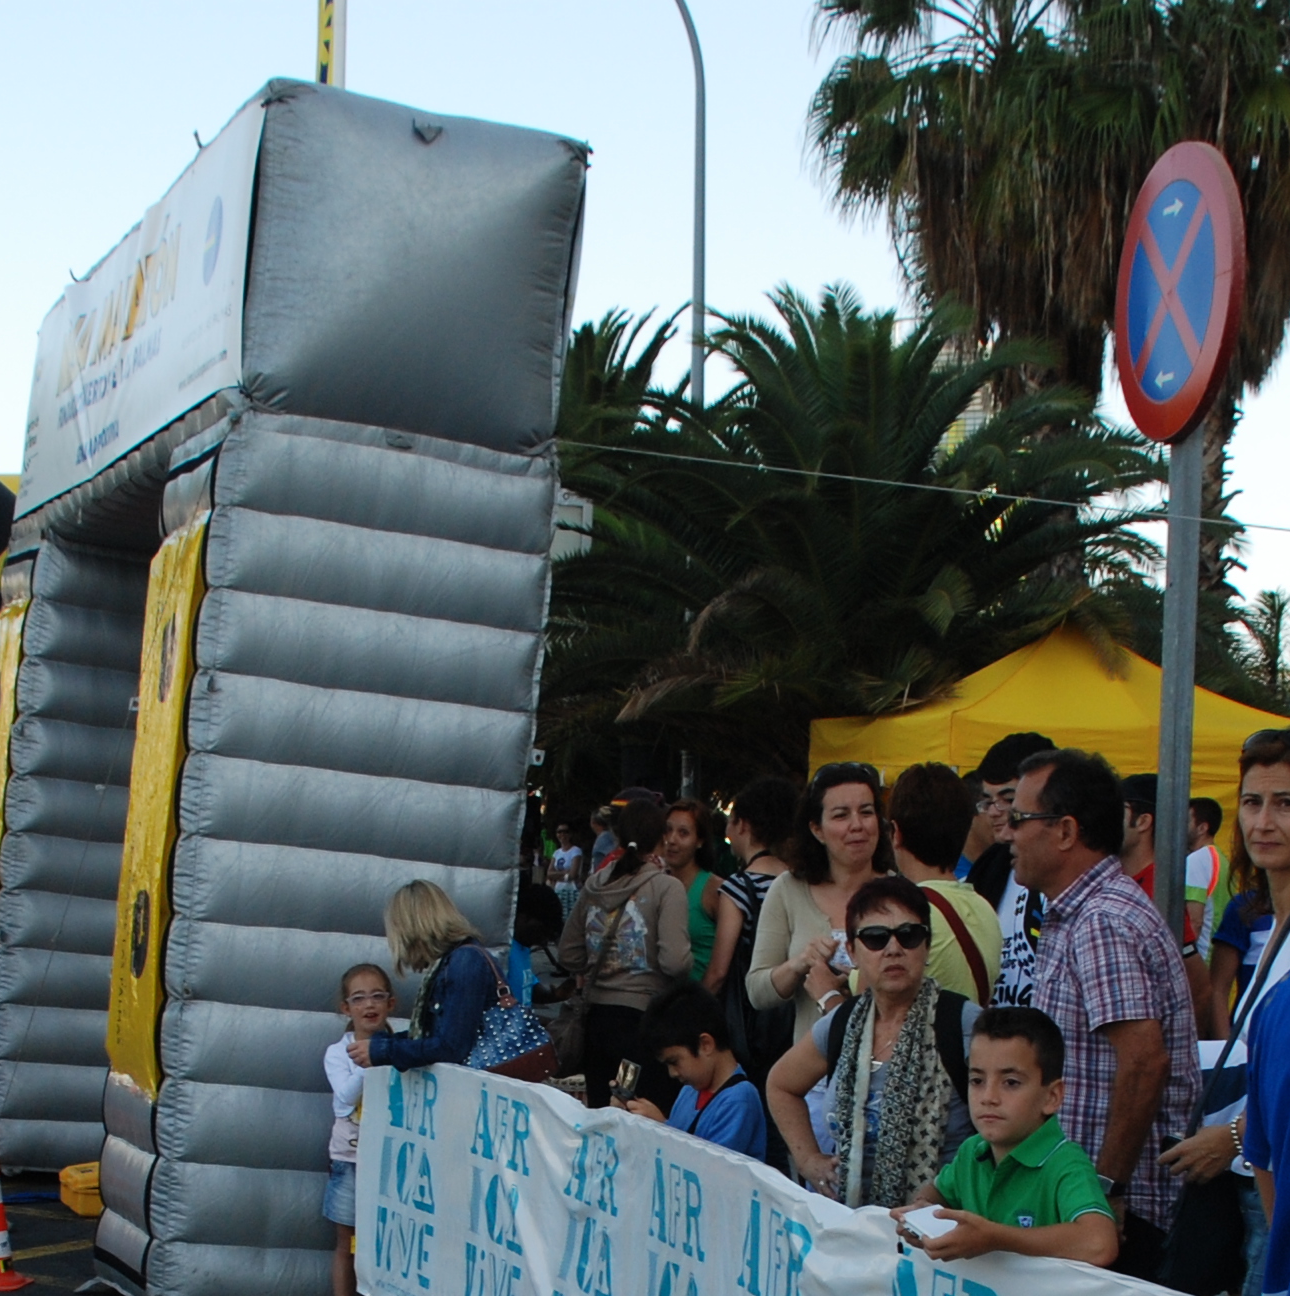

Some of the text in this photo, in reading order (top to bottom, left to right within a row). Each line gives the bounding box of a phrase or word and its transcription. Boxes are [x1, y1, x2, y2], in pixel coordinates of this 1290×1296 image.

[379, 1136, 435, 1214] ICA
[470, 1082, 529, 1176] ÁFR
[564, 1124, 619, 1217] ÁFR
[649, 1149, 705, 1263] ÁFR
